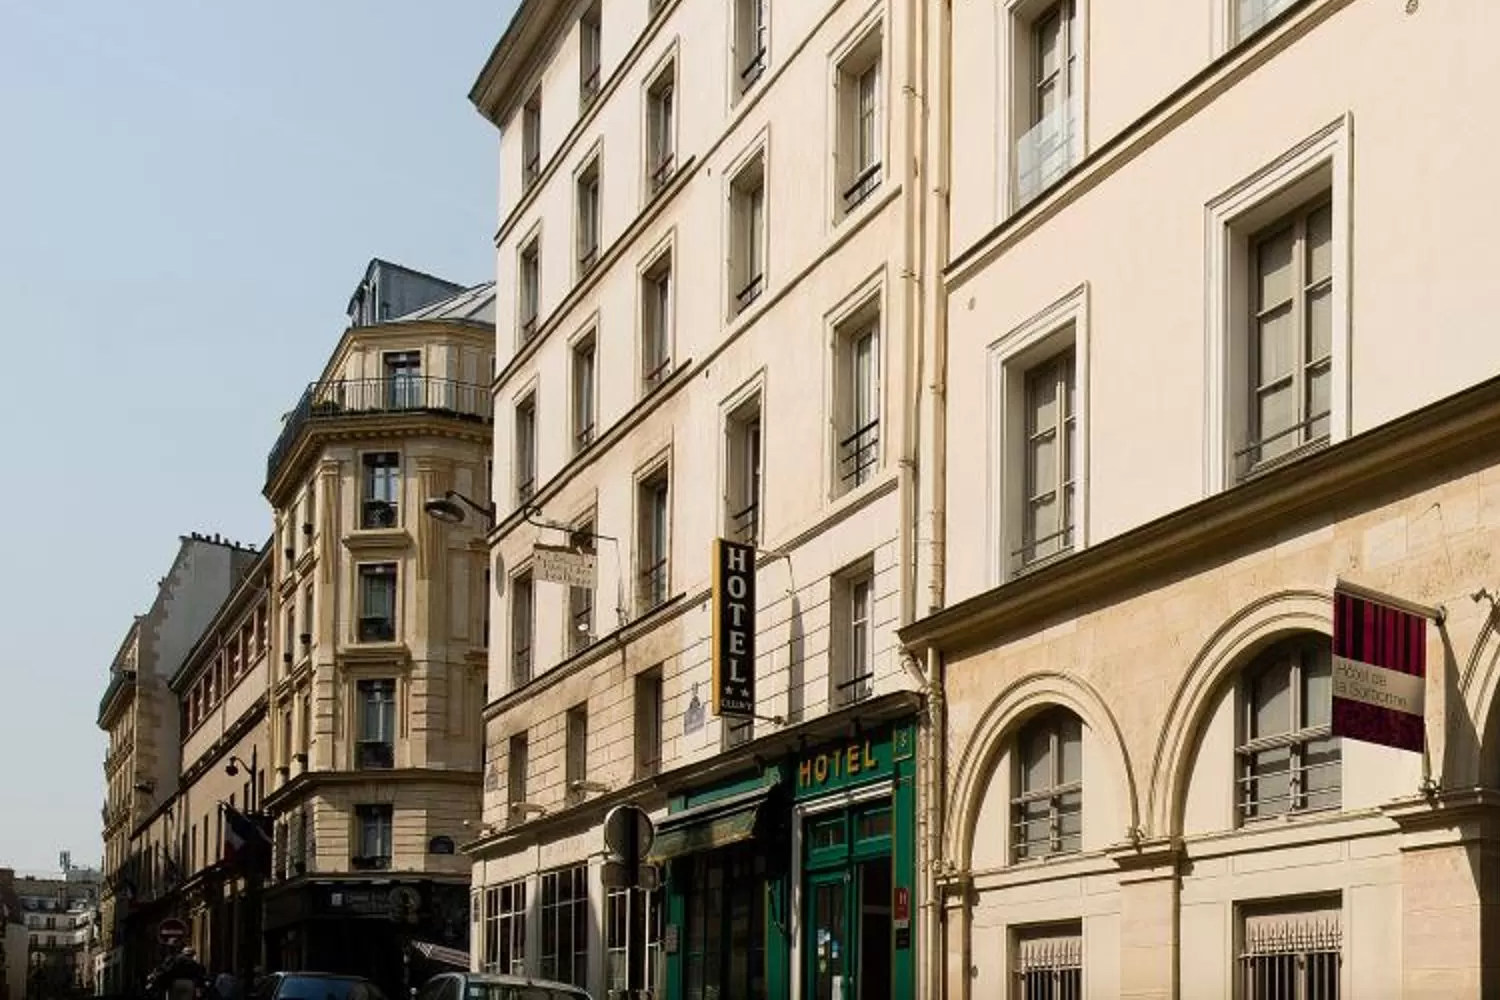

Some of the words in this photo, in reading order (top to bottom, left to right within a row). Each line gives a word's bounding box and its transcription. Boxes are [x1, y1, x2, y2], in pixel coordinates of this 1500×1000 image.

[727, 547, 747, 683] HOTEL
[1335, 678, 1346, 693] la
[1350, 682, 1408, 706] Sorbonne
[1371, 672, 1387, 687] de
[799, 740, 876, 787] HOTEL
